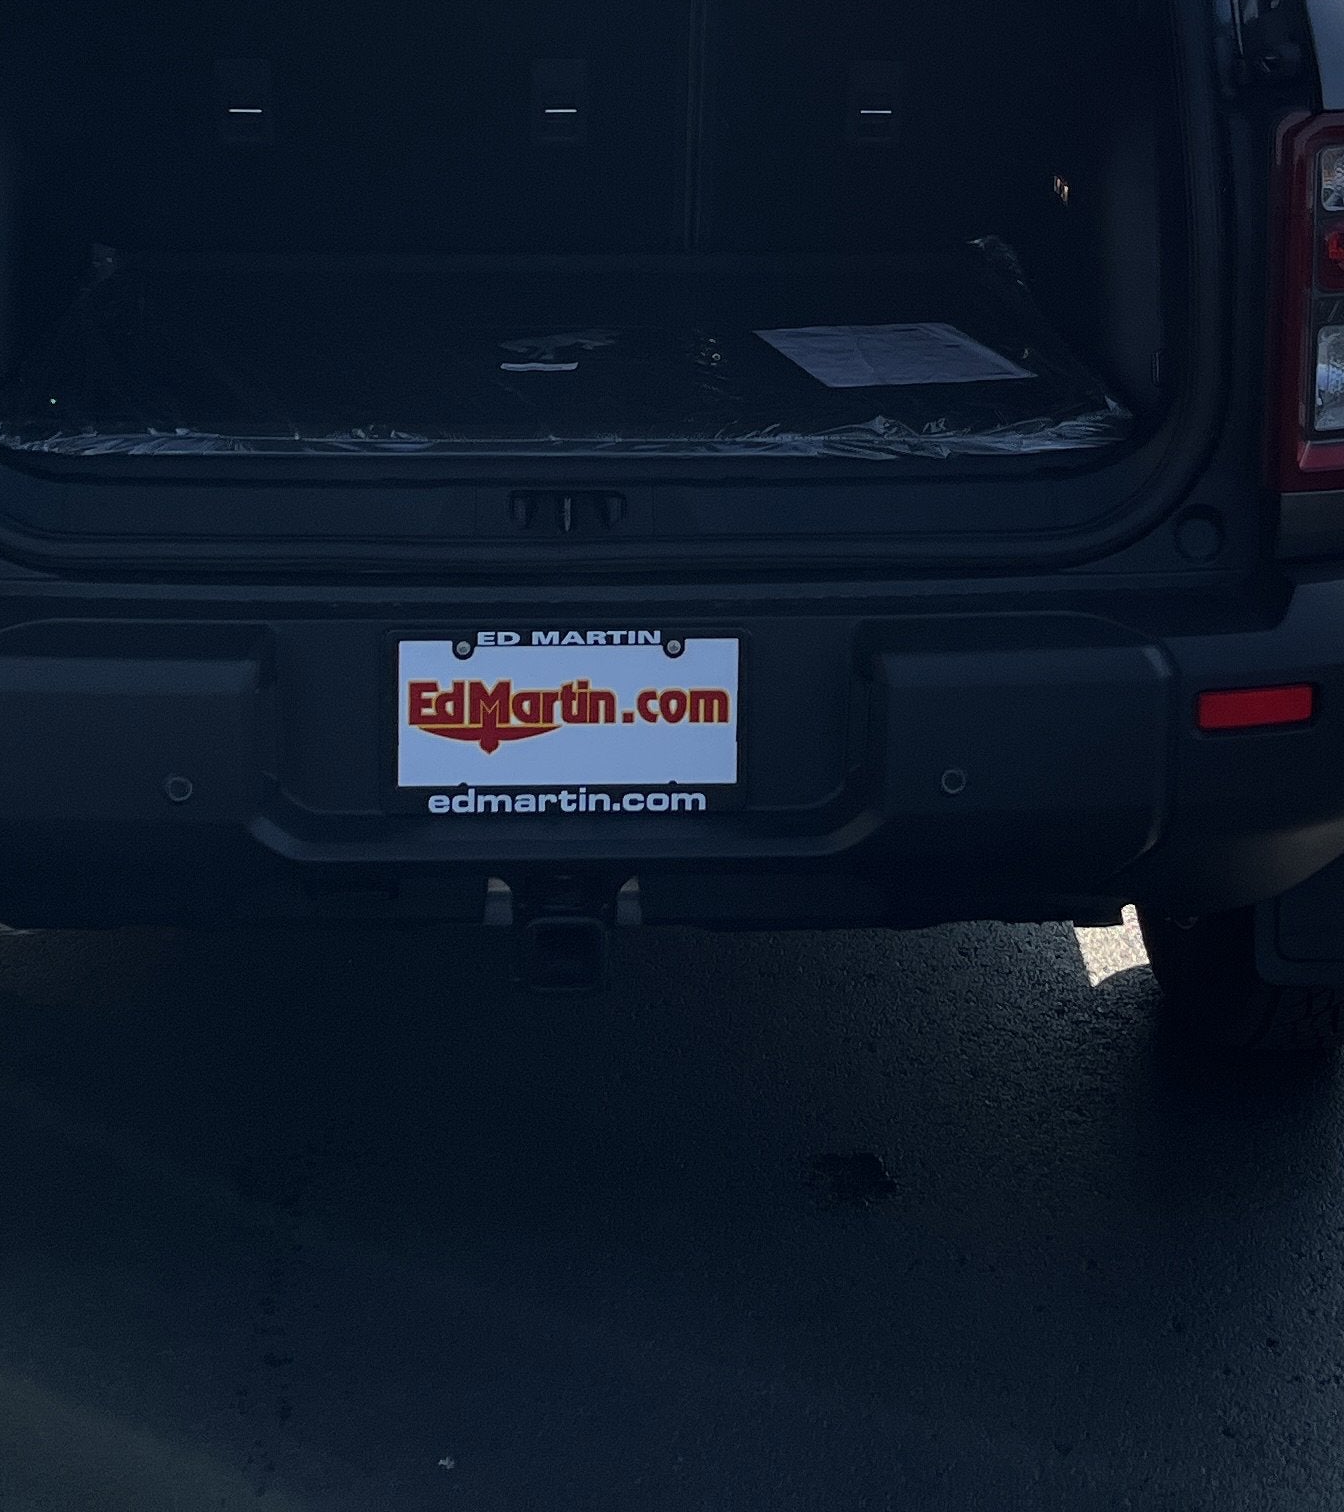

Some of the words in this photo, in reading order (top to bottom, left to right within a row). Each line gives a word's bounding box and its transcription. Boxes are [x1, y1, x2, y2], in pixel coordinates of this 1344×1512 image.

[477, 631, 521, 646] ED
[531, 630, 662, 645] MARTIN
[408, 679, 731, 754] EdMartin.com
[428, 787, 707, 813] edmartin.com
